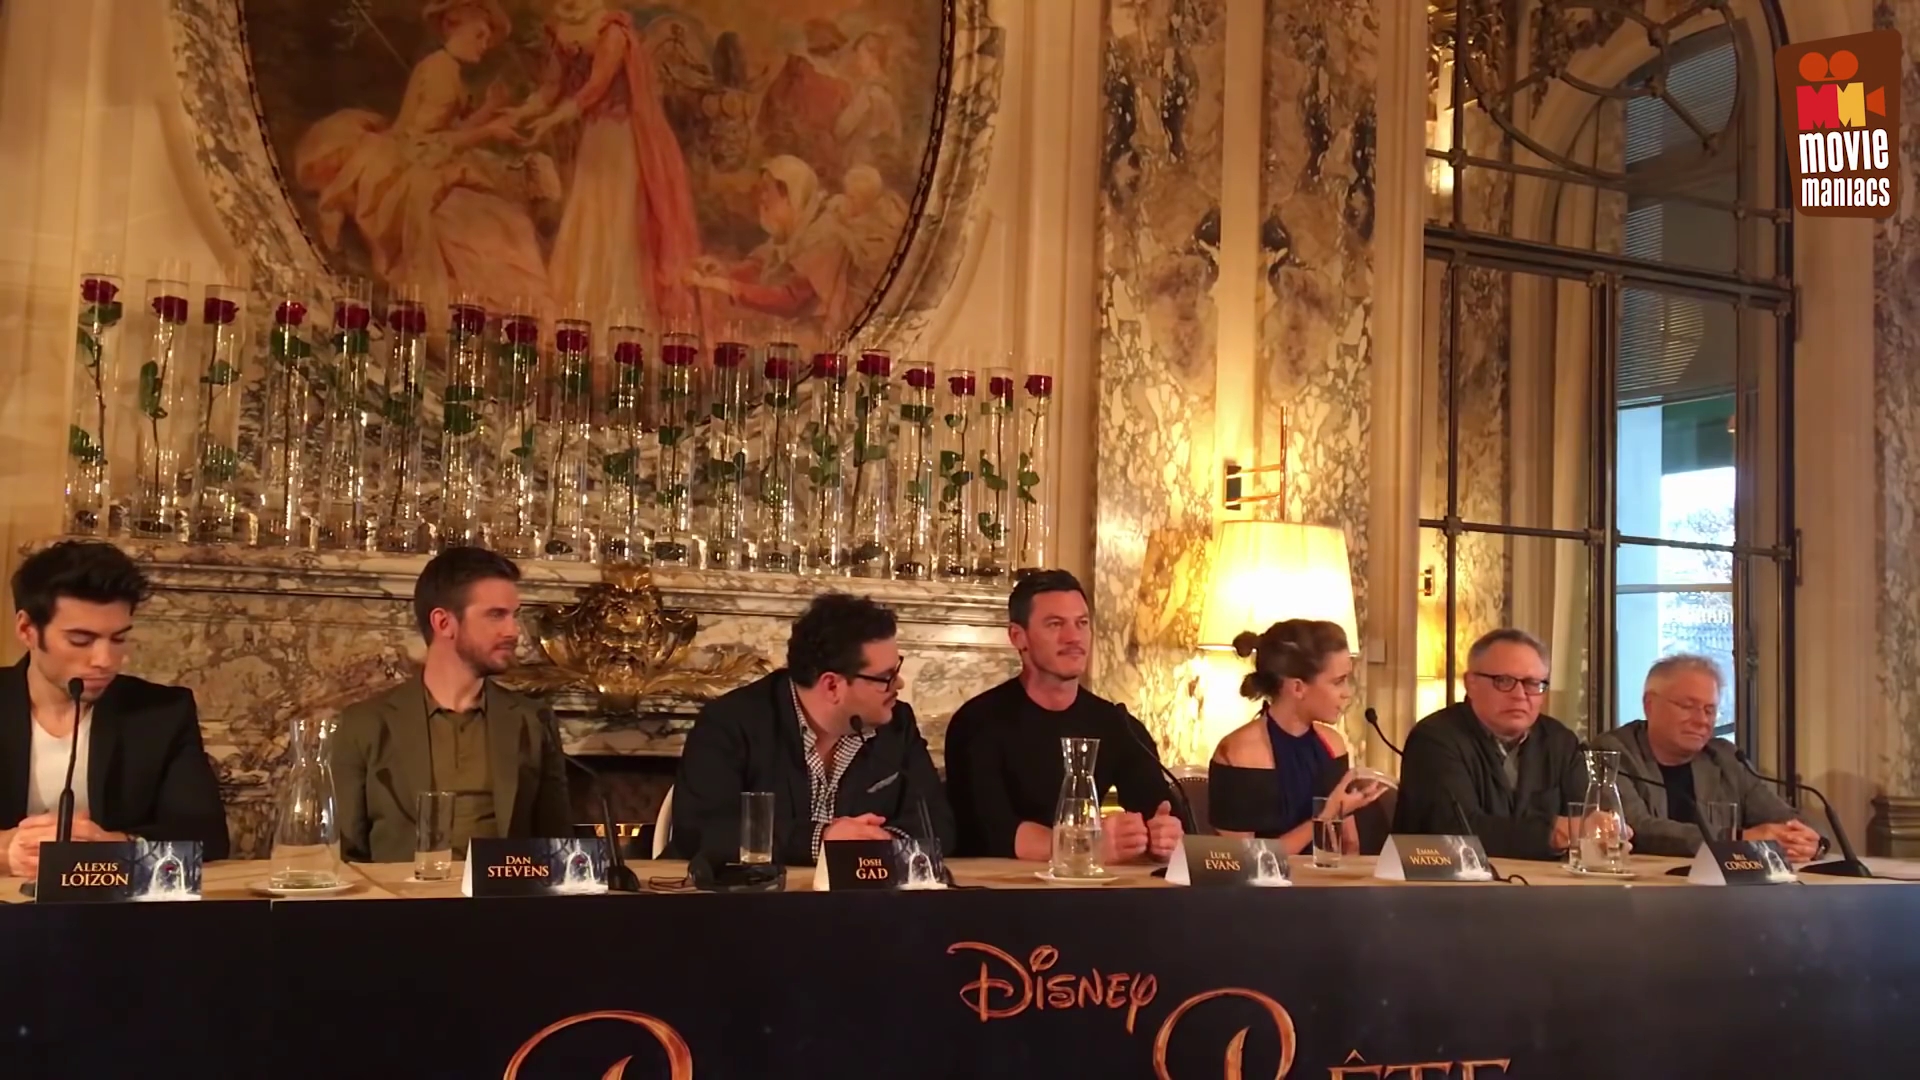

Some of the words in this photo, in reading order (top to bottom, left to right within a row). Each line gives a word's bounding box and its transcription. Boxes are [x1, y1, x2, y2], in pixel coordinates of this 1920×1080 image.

[505, 855, 531, 865] DAN
[1210, 850, 1232, 860] LUKE
[859, 857, 882, 867] JOSH
[1205, 859, 1241, 871] EVANS
[1409, 855, 1452, 866] WATSON
[1724, 860, 1764, 870] CONDON
[73, 862, 118, 872] ALEXIS
[487, 865, 550, 878] STEVENS
[855, 868, 889, 879] GAD
[61, 873, 129, 887] LOIZON
